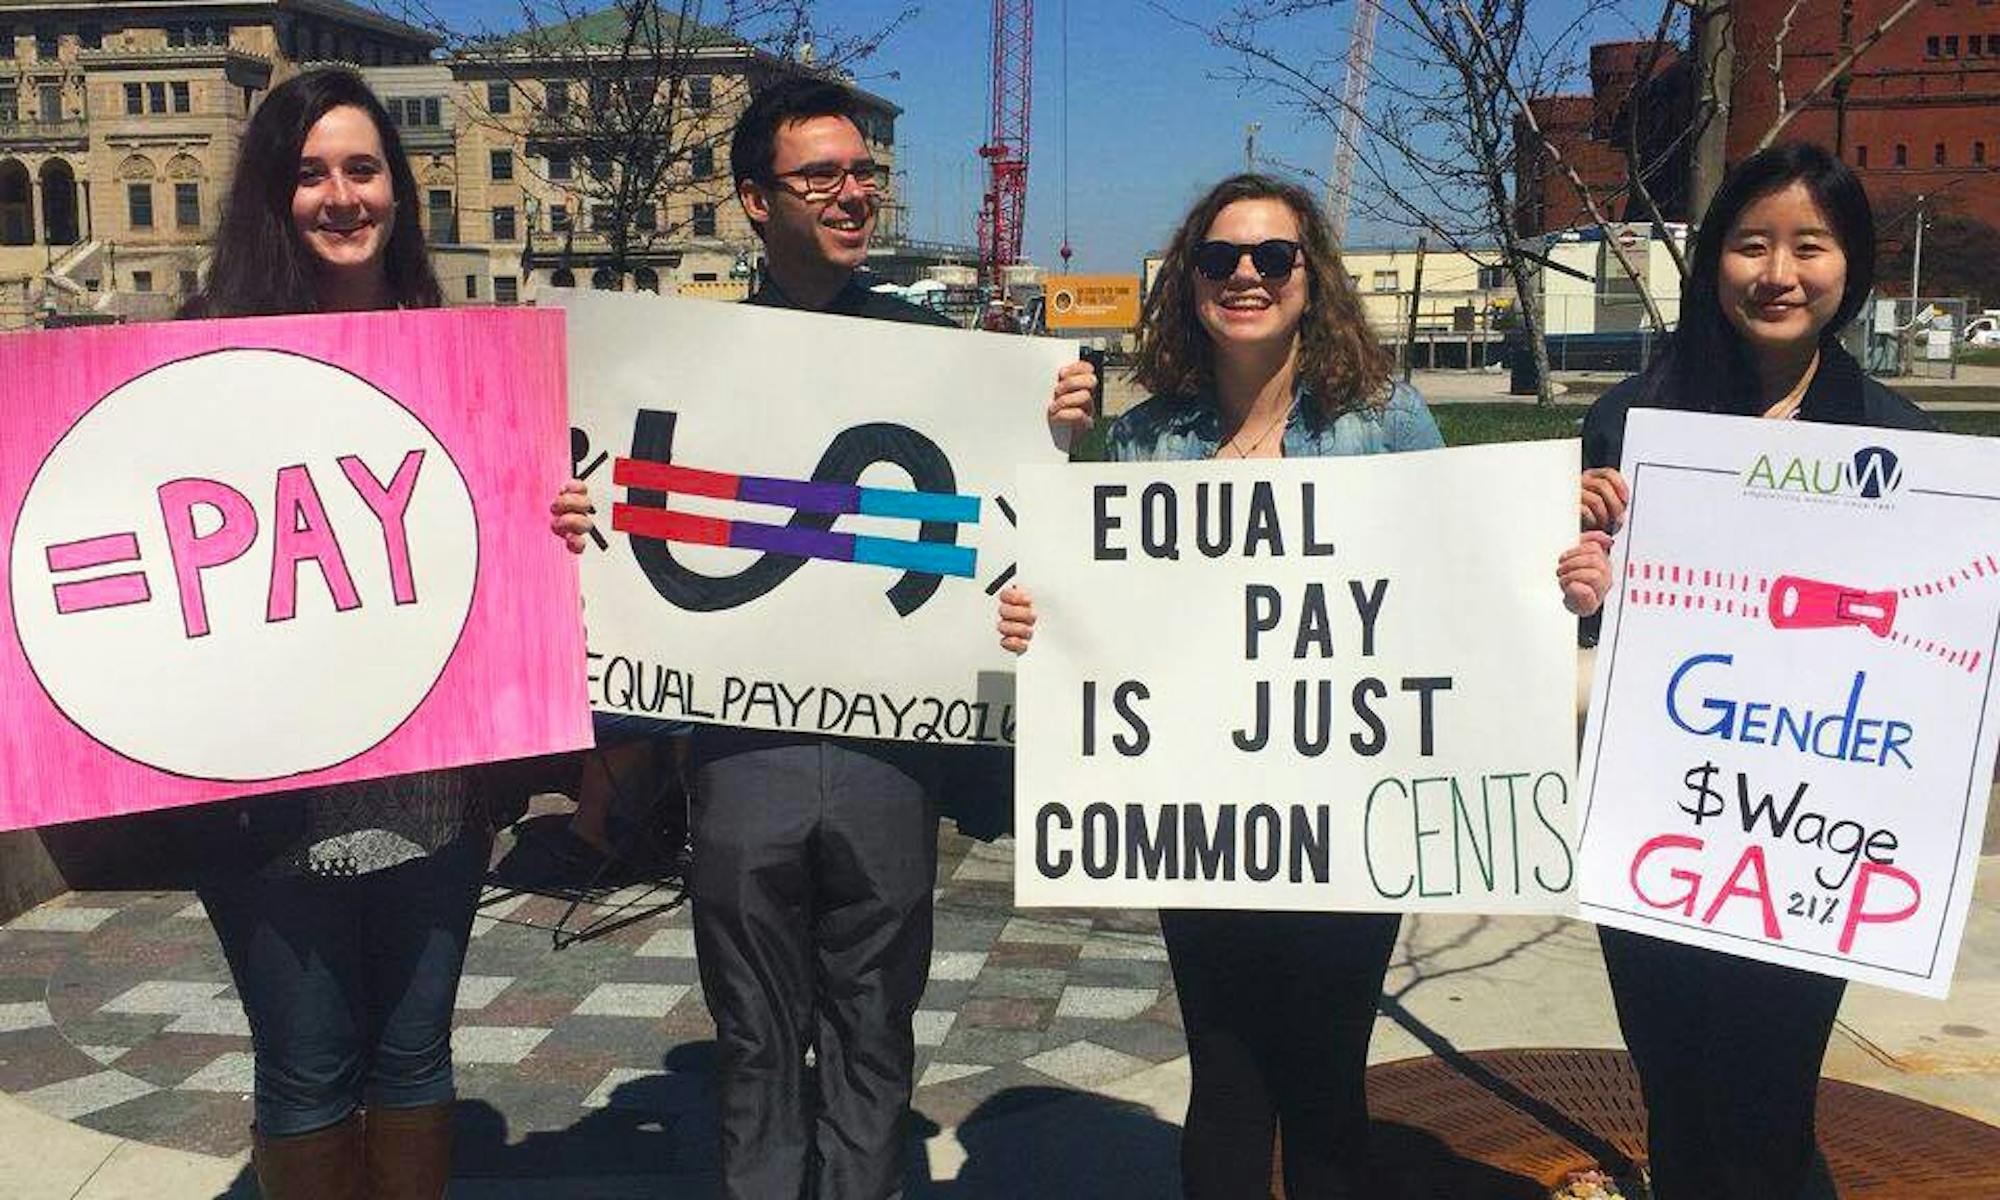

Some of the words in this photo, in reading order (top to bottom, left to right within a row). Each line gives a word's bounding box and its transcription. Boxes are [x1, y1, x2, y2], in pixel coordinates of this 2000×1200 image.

[1746, 446, 1902, 499] AAUW
[1093, 481, 1335, 561] EQUAL
[1245, 579, 1390, 660] PAY
[1082, 680, 1152, 757] IS
[1232, 676, 1453, 758] JUST
[1035, 802, 1331, 884] COMMON
[1364, 771, 1575, 899] CENTS
[1787, 891, 1842, 925] 21%
